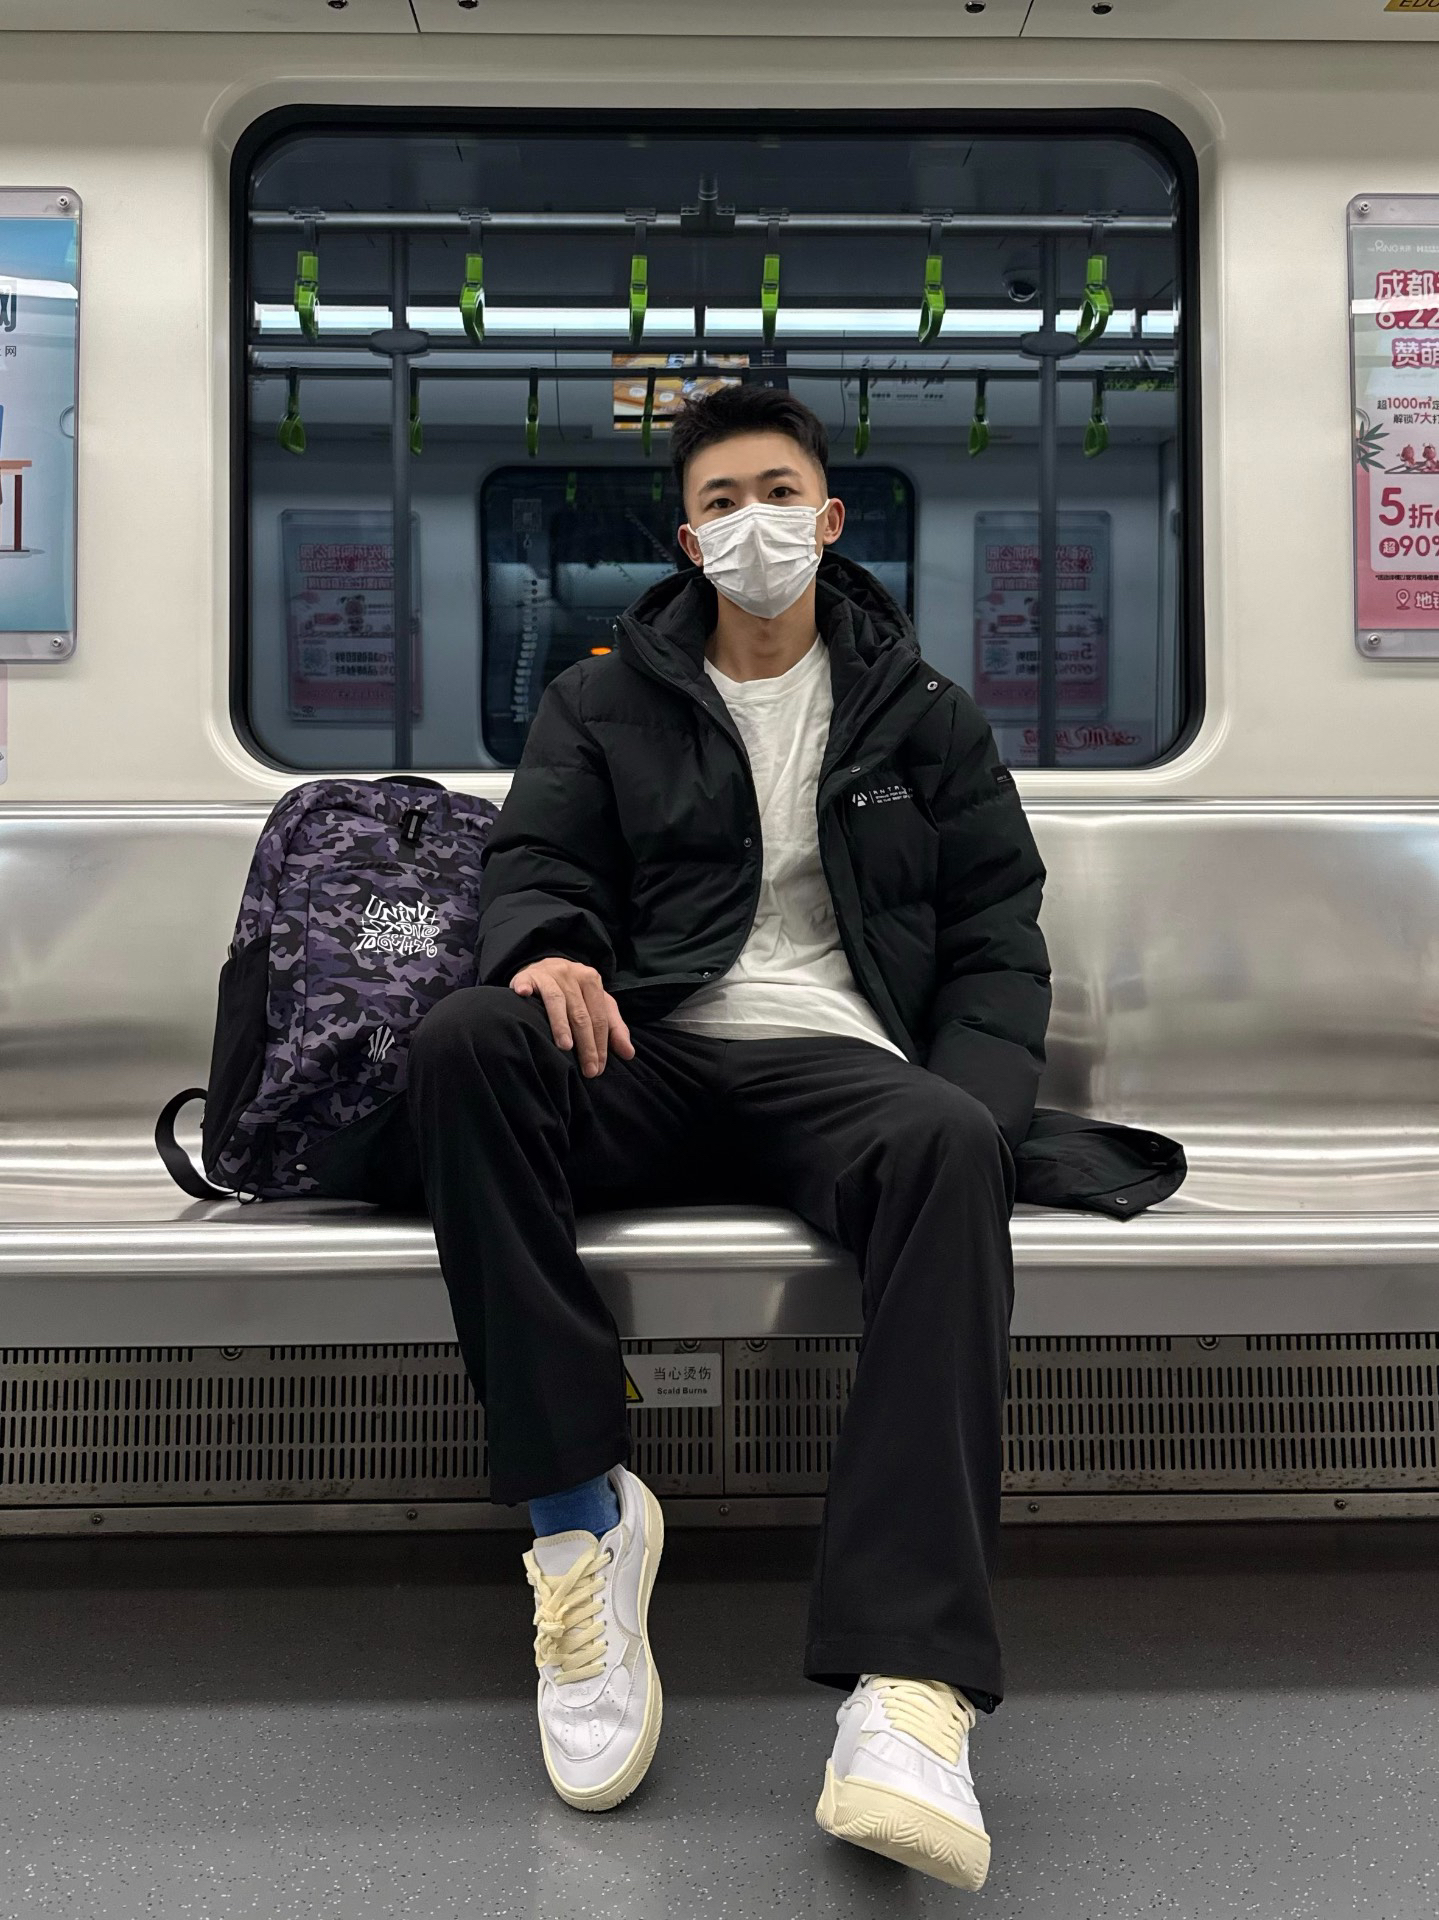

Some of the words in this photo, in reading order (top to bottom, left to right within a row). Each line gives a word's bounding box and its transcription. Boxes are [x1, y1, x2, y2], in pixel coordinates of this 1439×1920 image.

[1377, 272, 1439, 300] 成都
[354, 929, 438, 958] TOGETHER
[654, 1366, 712, 1381] 当心烫伤
[657, 1387, 681, 1395] Scald
[682, 1387, 708, 1395] Burns
